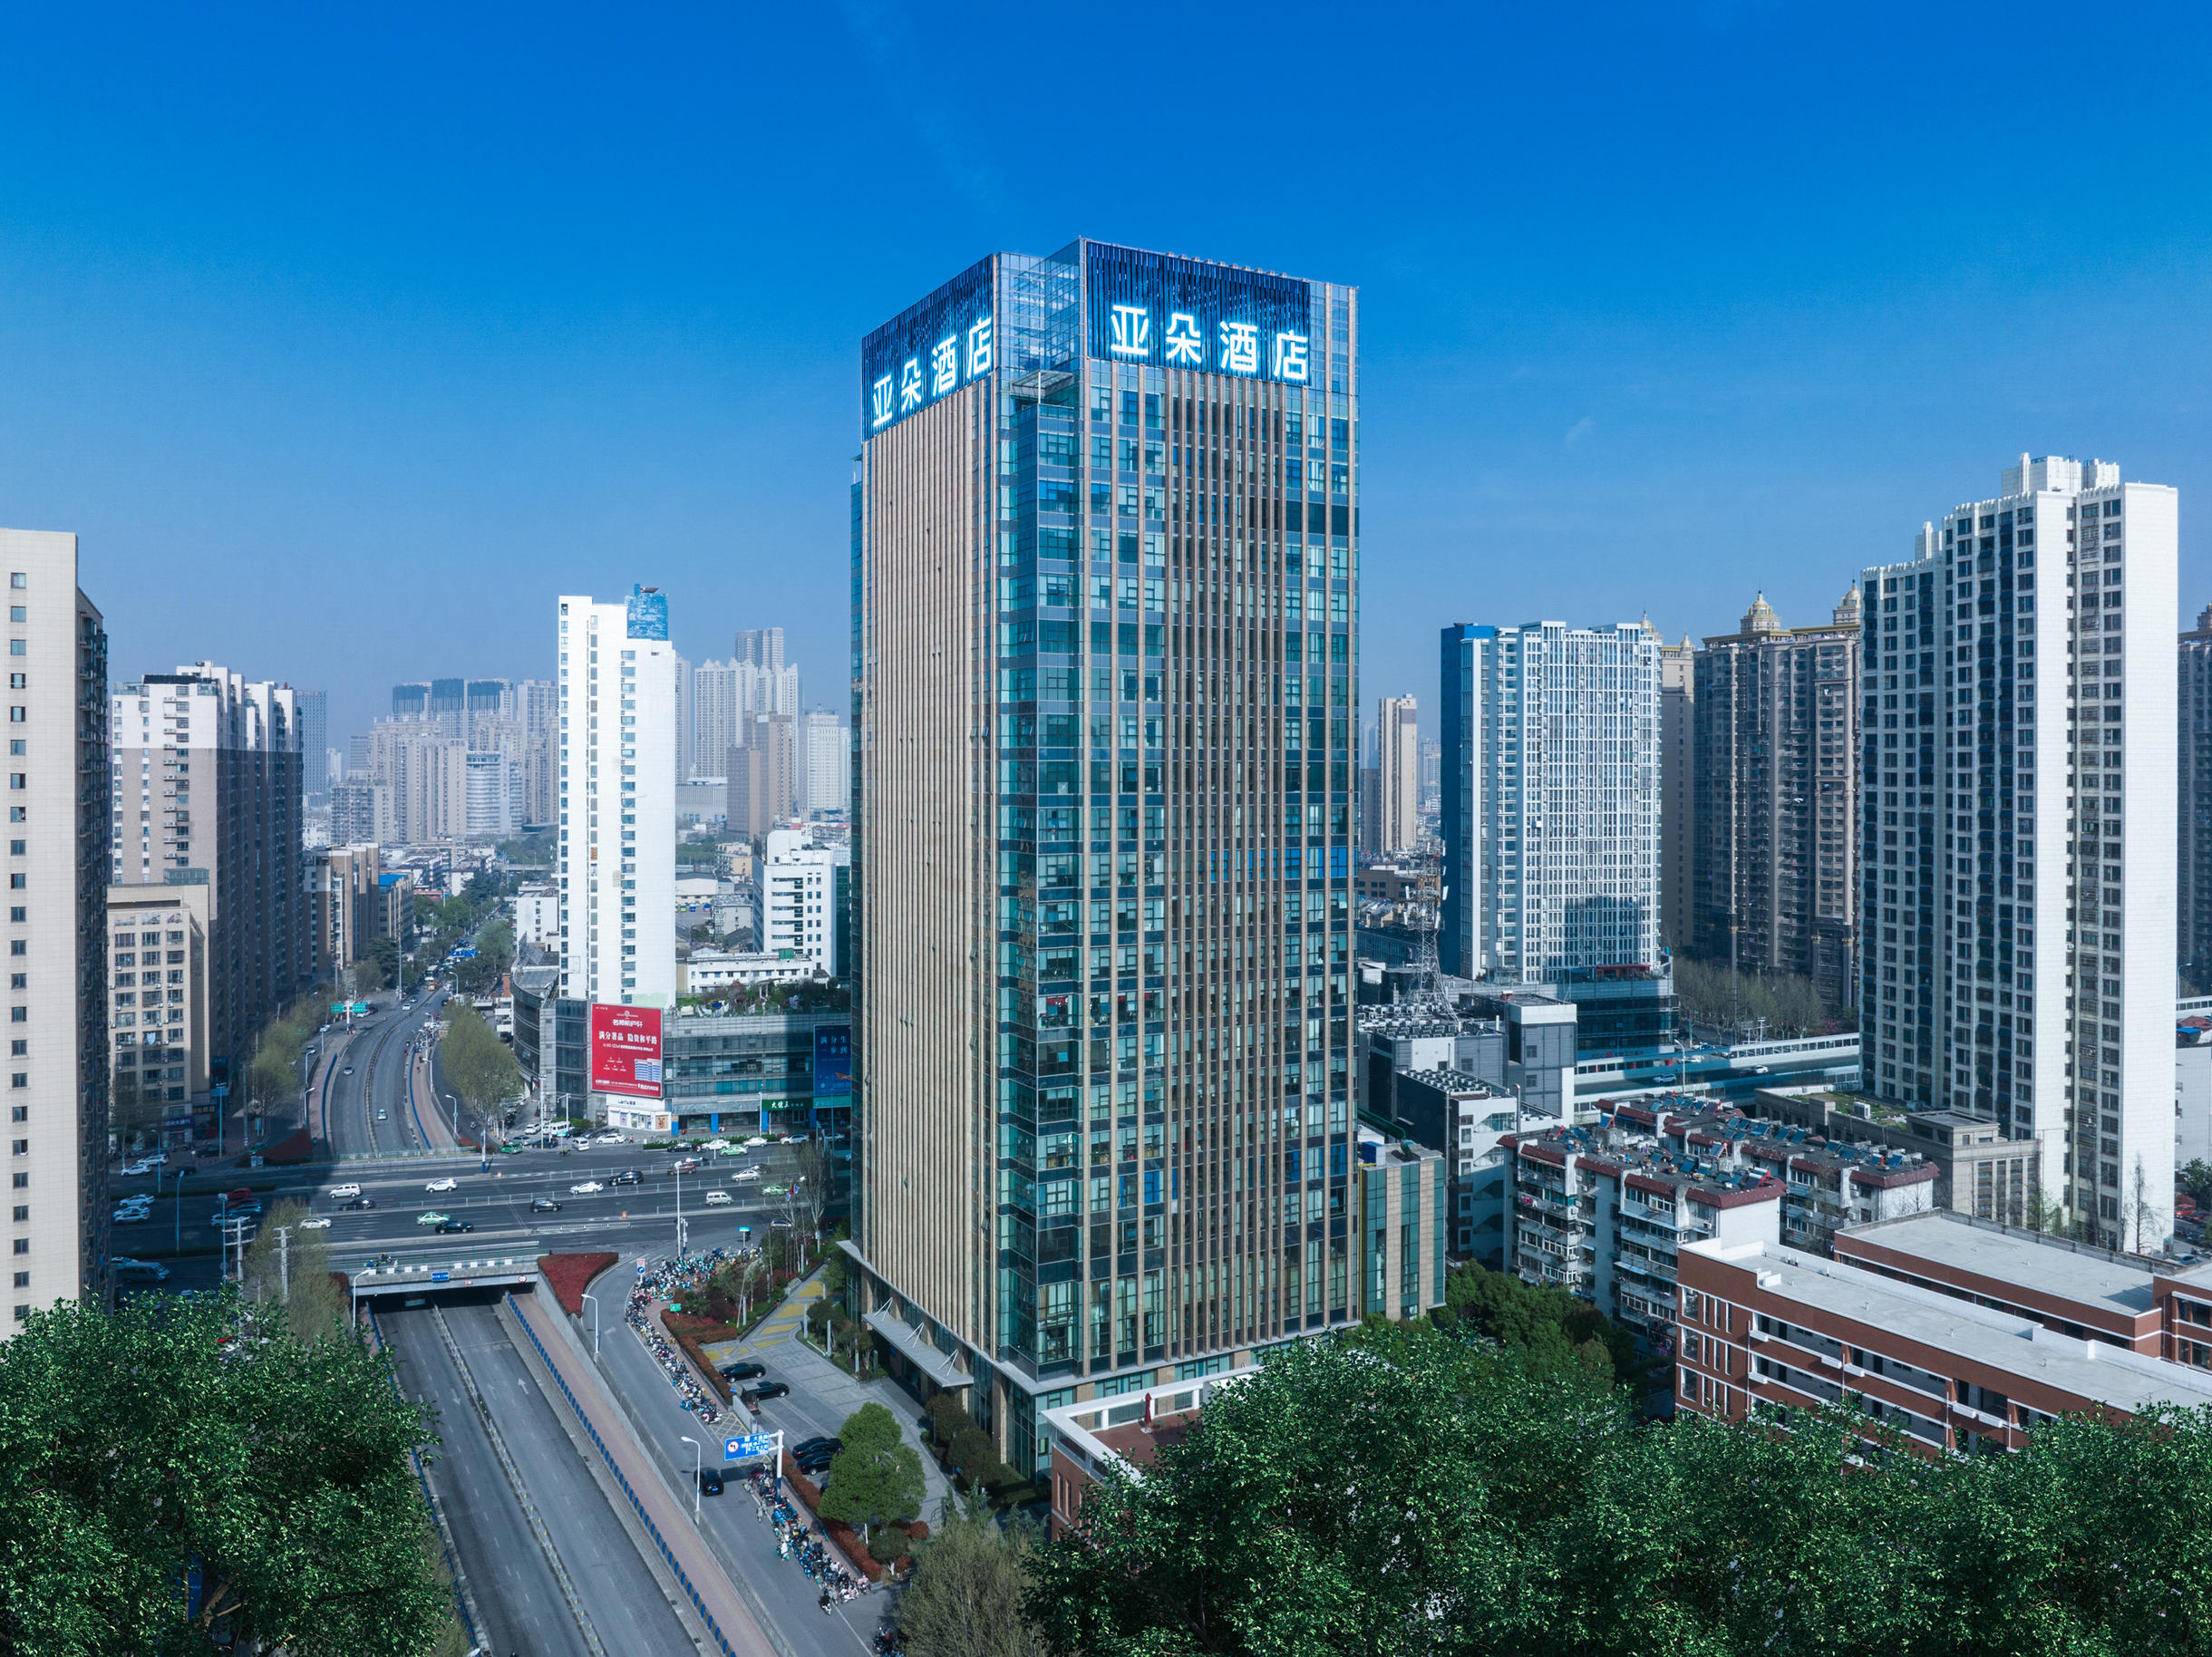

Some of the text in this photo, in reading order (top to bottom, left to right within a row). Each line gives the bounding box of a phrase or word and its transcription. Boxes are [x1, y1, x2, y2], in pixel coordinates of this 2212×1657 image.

[872, 316, 993, 427] 亚朵酒店
[1110, 305, 1308, 381] 亚朵酒店
